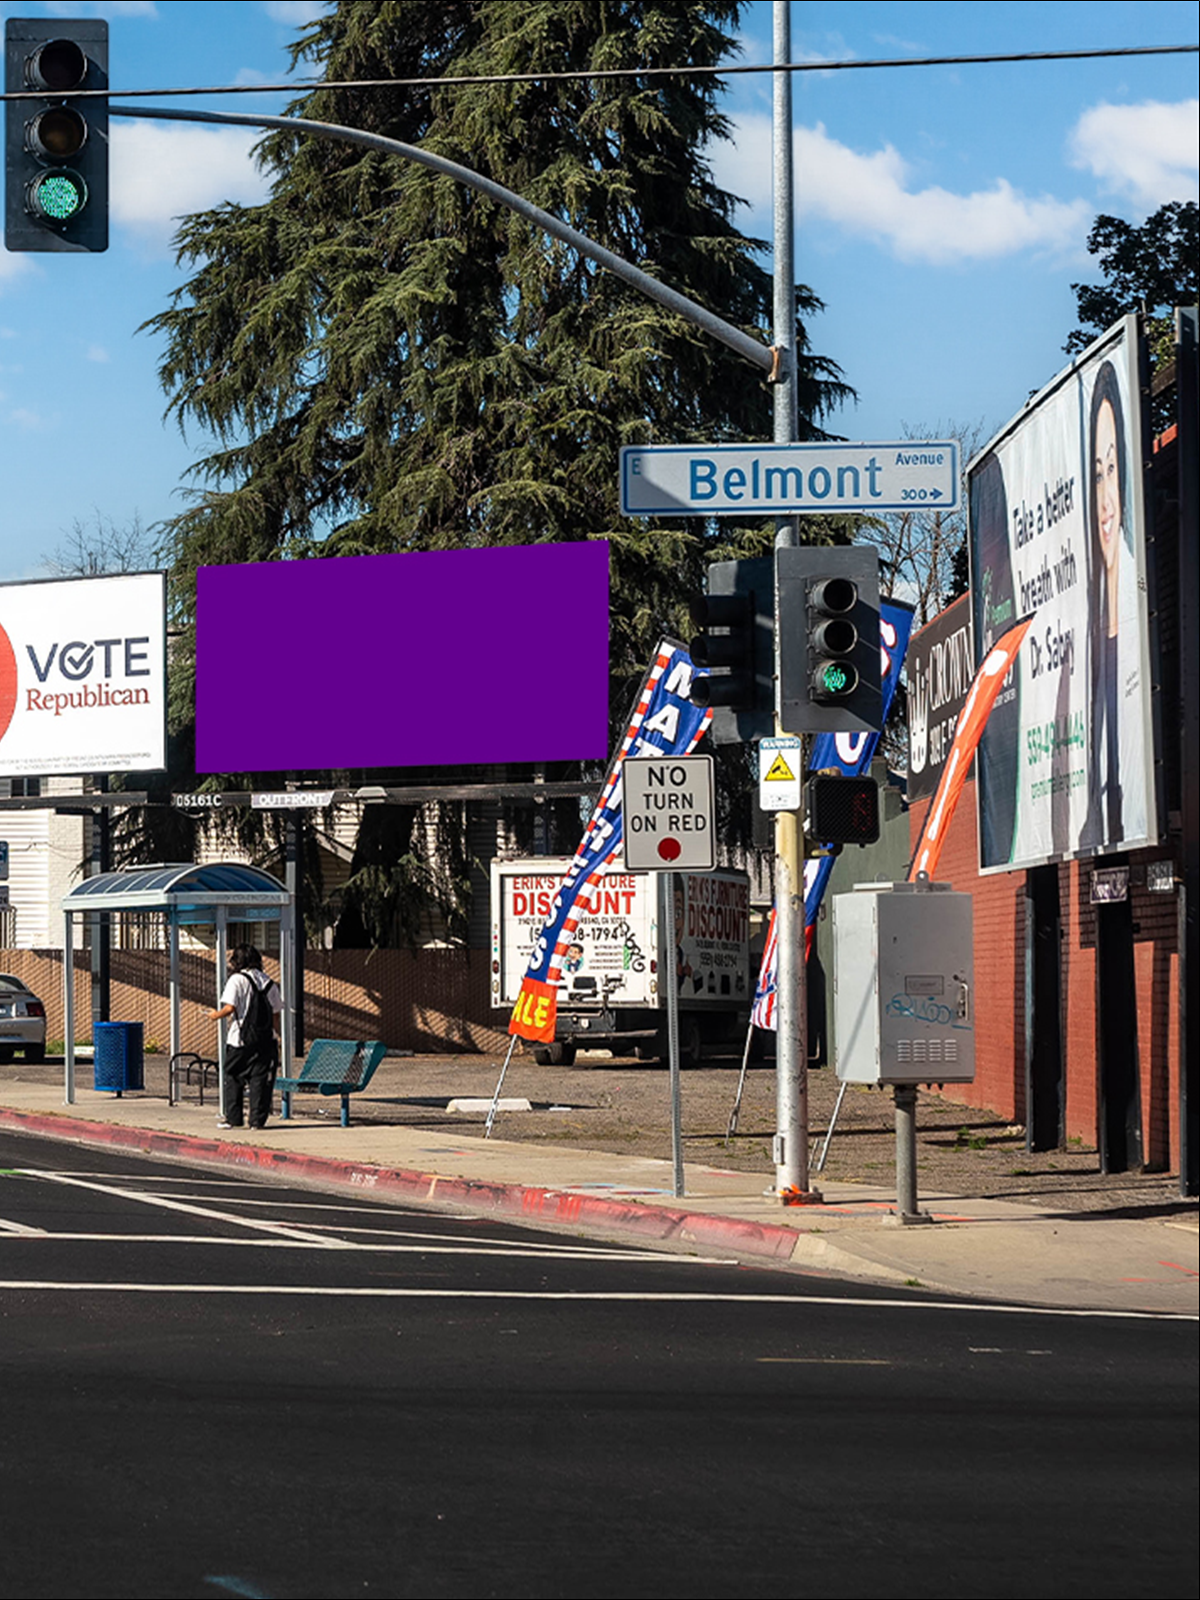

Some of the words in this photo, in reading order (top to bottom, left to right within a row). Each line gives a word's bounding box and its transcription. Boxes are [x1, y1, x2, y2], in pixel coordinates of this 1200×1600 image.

[631, 457, 641, 475] E
[895, 453, 944, 466] Avenue
[689, 458, 882, 501] Belmont
[901, 489, 927, 500] 300
[1013, 500, 1034, 550] Take
[1044, 477, 1074, 528] better
[1018, 553, 1054, 614] breath
[1053, 537, 1078, 594] with
[25, 636, 151, 683] VOTE
[1029, 636, 1044, 680] Dr.
[1045, 618, 1075, 676] Sabry
[929, 622, 975, 711] CROWN
[26, 682, 151, 717] Republican
[648, 766, 687, 787] NO
[258, 793, 326, 806] OUTFRONT
[643, 793, 694, 810] TURN
[631, 815, 657, 832] ON
[669, 815, 707, 831] RED
[513, 876, 556, 890] ERIK'S
[513, 891, 636, 916] DISUNT
[688, 902, 748, 944] DISCOUNT
